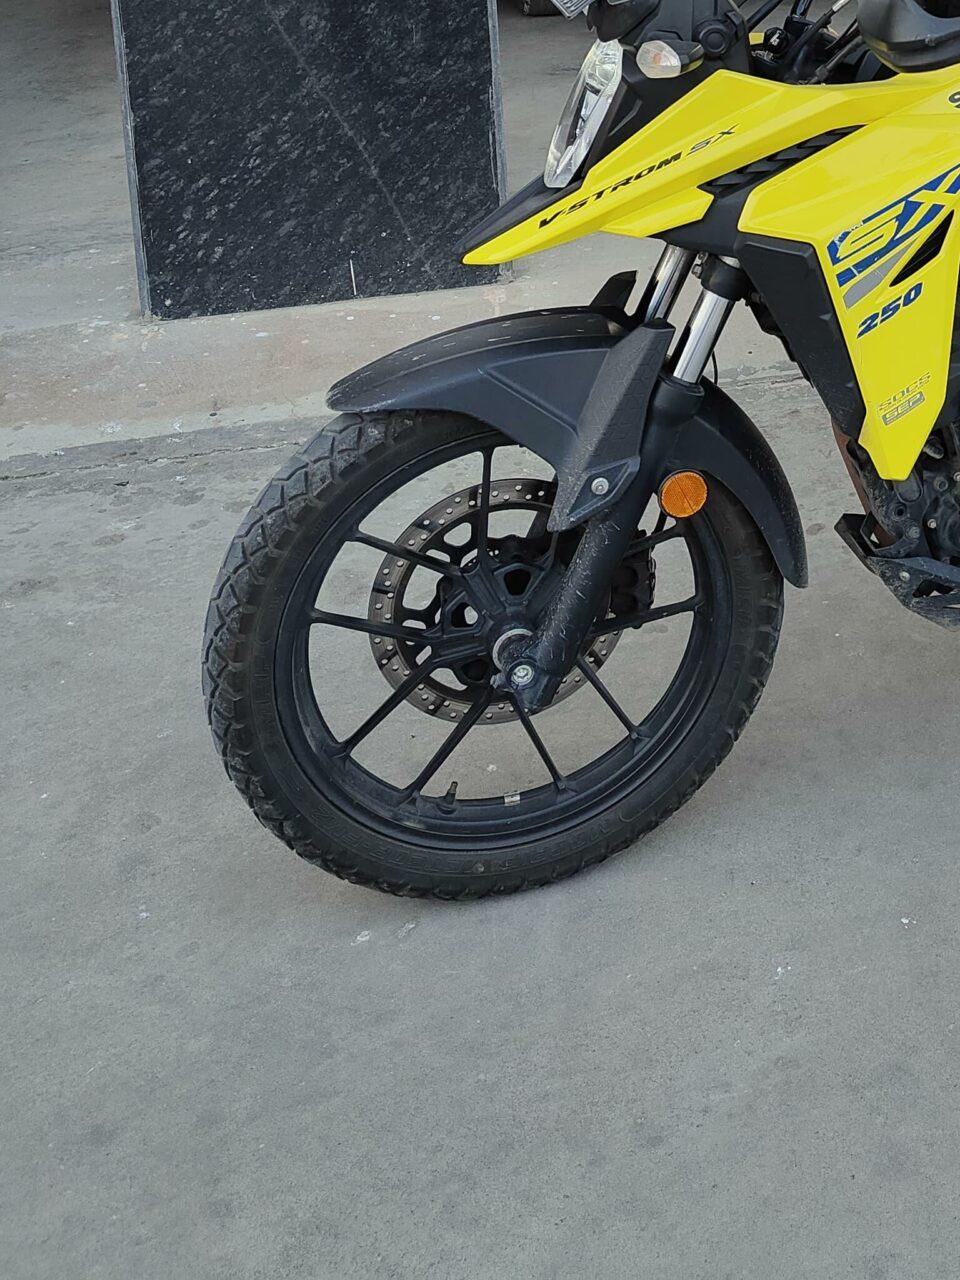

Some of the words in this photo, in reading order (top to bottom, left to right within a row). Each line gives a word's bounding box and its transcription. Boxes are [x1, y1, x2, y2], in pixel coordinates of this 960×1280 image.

[539, 151, 682, 229] V-STROM
[687, 123, 739, 156] SX
[857, 281, 924, 339] 250
